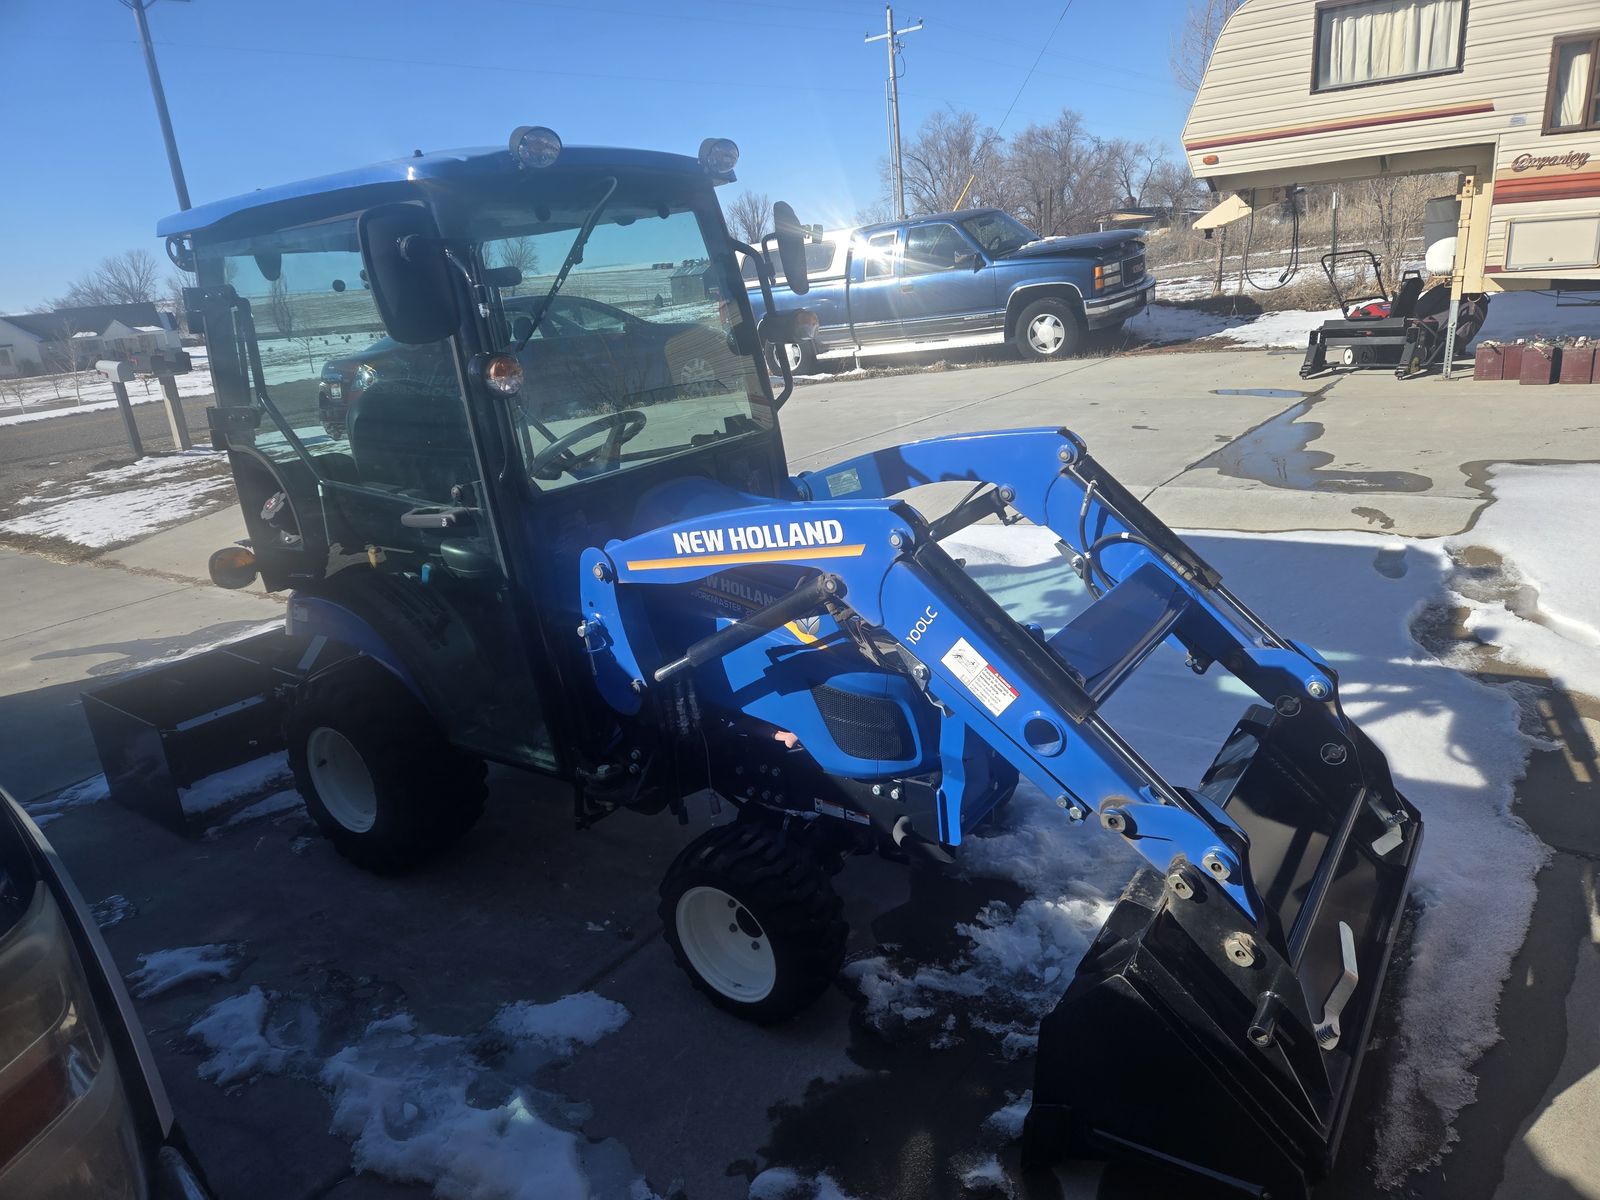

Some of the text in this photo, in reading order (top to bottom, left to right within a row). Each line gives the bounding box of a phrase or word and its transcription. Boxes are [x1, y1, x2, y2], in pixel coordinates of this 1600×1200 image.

[673, 519, 844, 554] NEW HOLLAND
[720, 578, 777, 607] HOLLAN
[905, 605, 938, 645] 100LC
